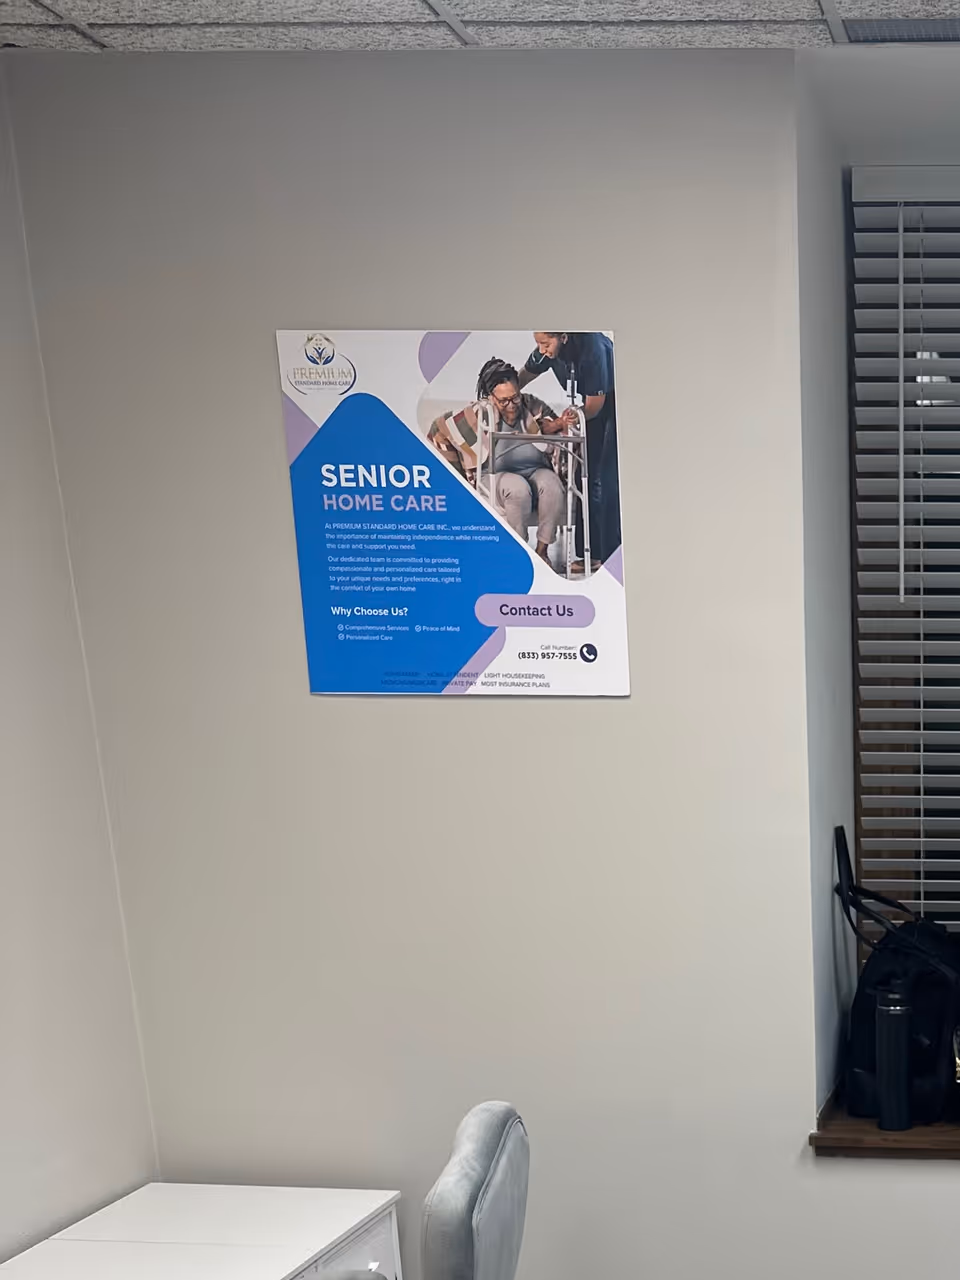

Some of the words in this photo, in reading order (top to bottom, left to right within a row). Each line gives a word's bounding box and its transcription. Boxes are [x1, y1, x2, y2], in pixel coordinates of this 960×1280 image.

[293, 367, 352, 379] PREMIUM
[321, 464, 431, 488] SENIOR
[323, 494, 385, 512] HOME
[391, 495, 447, 512] CARE
[331, 606, 352, 617] Why
[354, 607, 388, 616] Choose
[391, 608, 408, 616] Us?
[499, 604, 552, 617] Contact
[555, 605, 573, 617] Us
[518, 652, 538, 660] (833)
[541, 652, 577, 660] 957-7555
